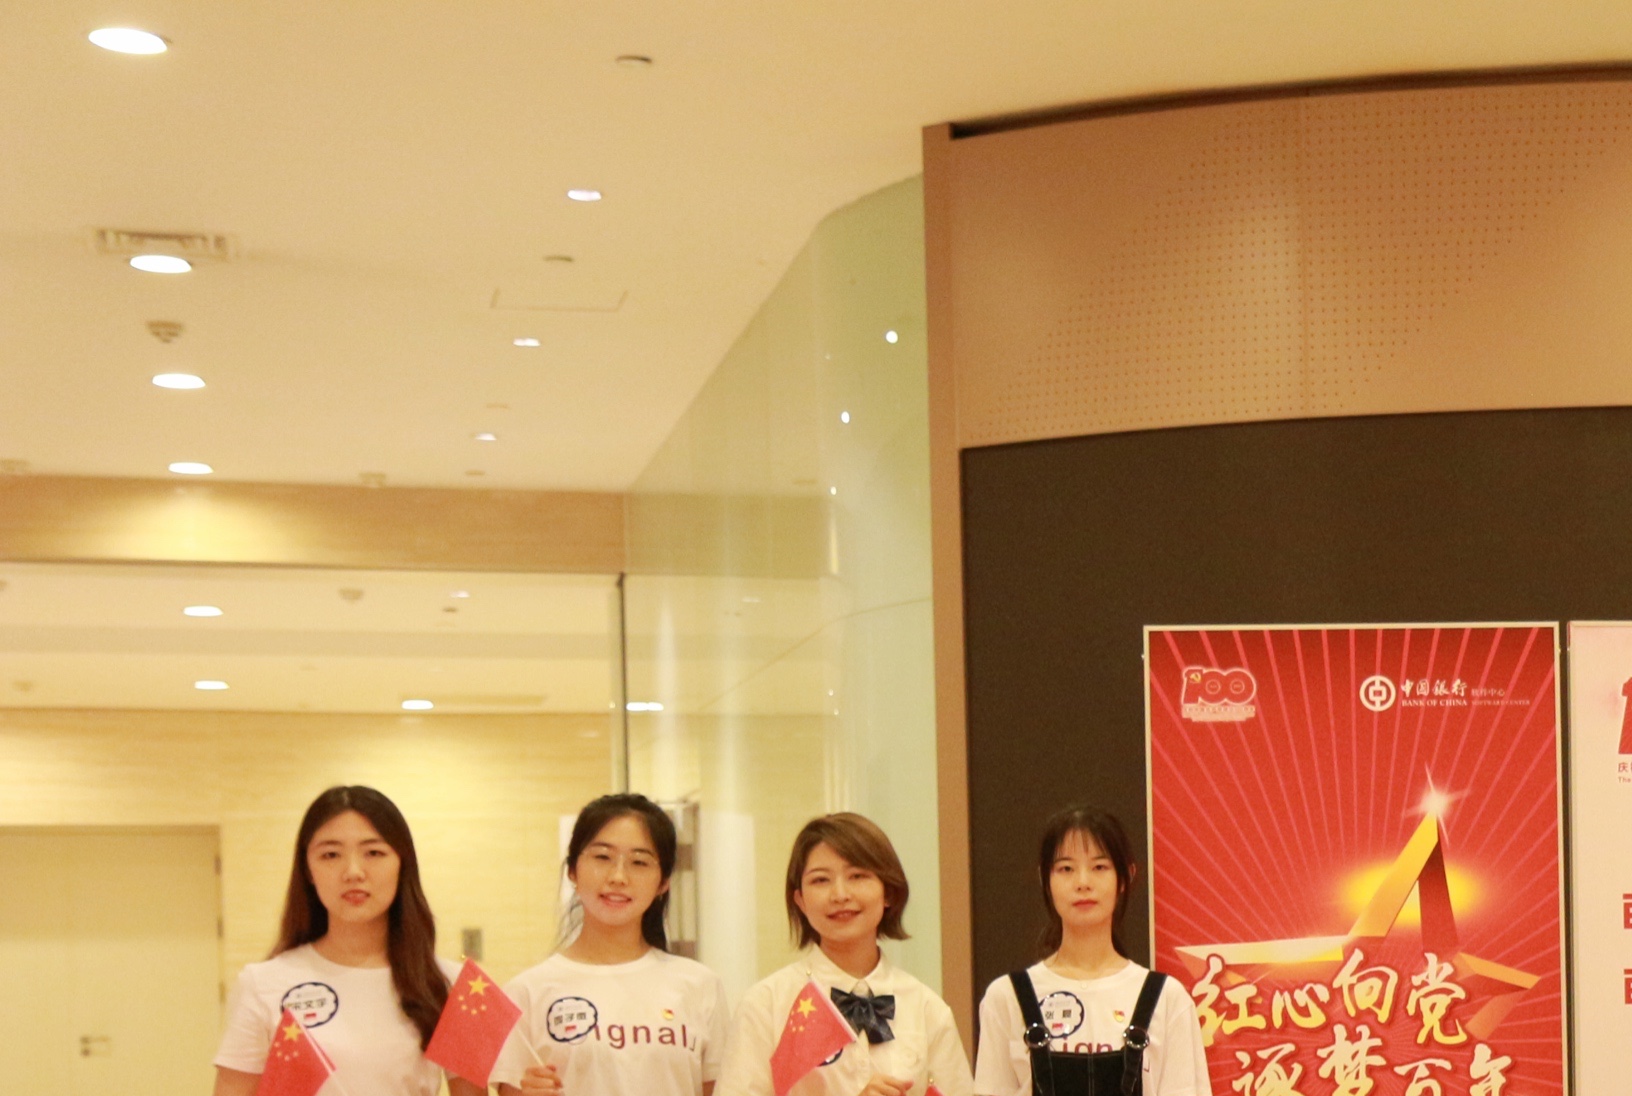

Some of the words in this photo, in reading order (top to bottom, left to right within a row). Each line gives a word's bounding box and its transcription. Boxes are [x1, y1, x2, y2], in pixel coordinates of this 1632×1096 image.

[1400, 678, 1468, 698] 中国银行
[1401, 699, 1425, 707] BANK
[1426, 699, 1438, 707] OF
[1439, 699, 1468, 707] CHINA
[1192, 948, 1468, 1047] 红心向党
